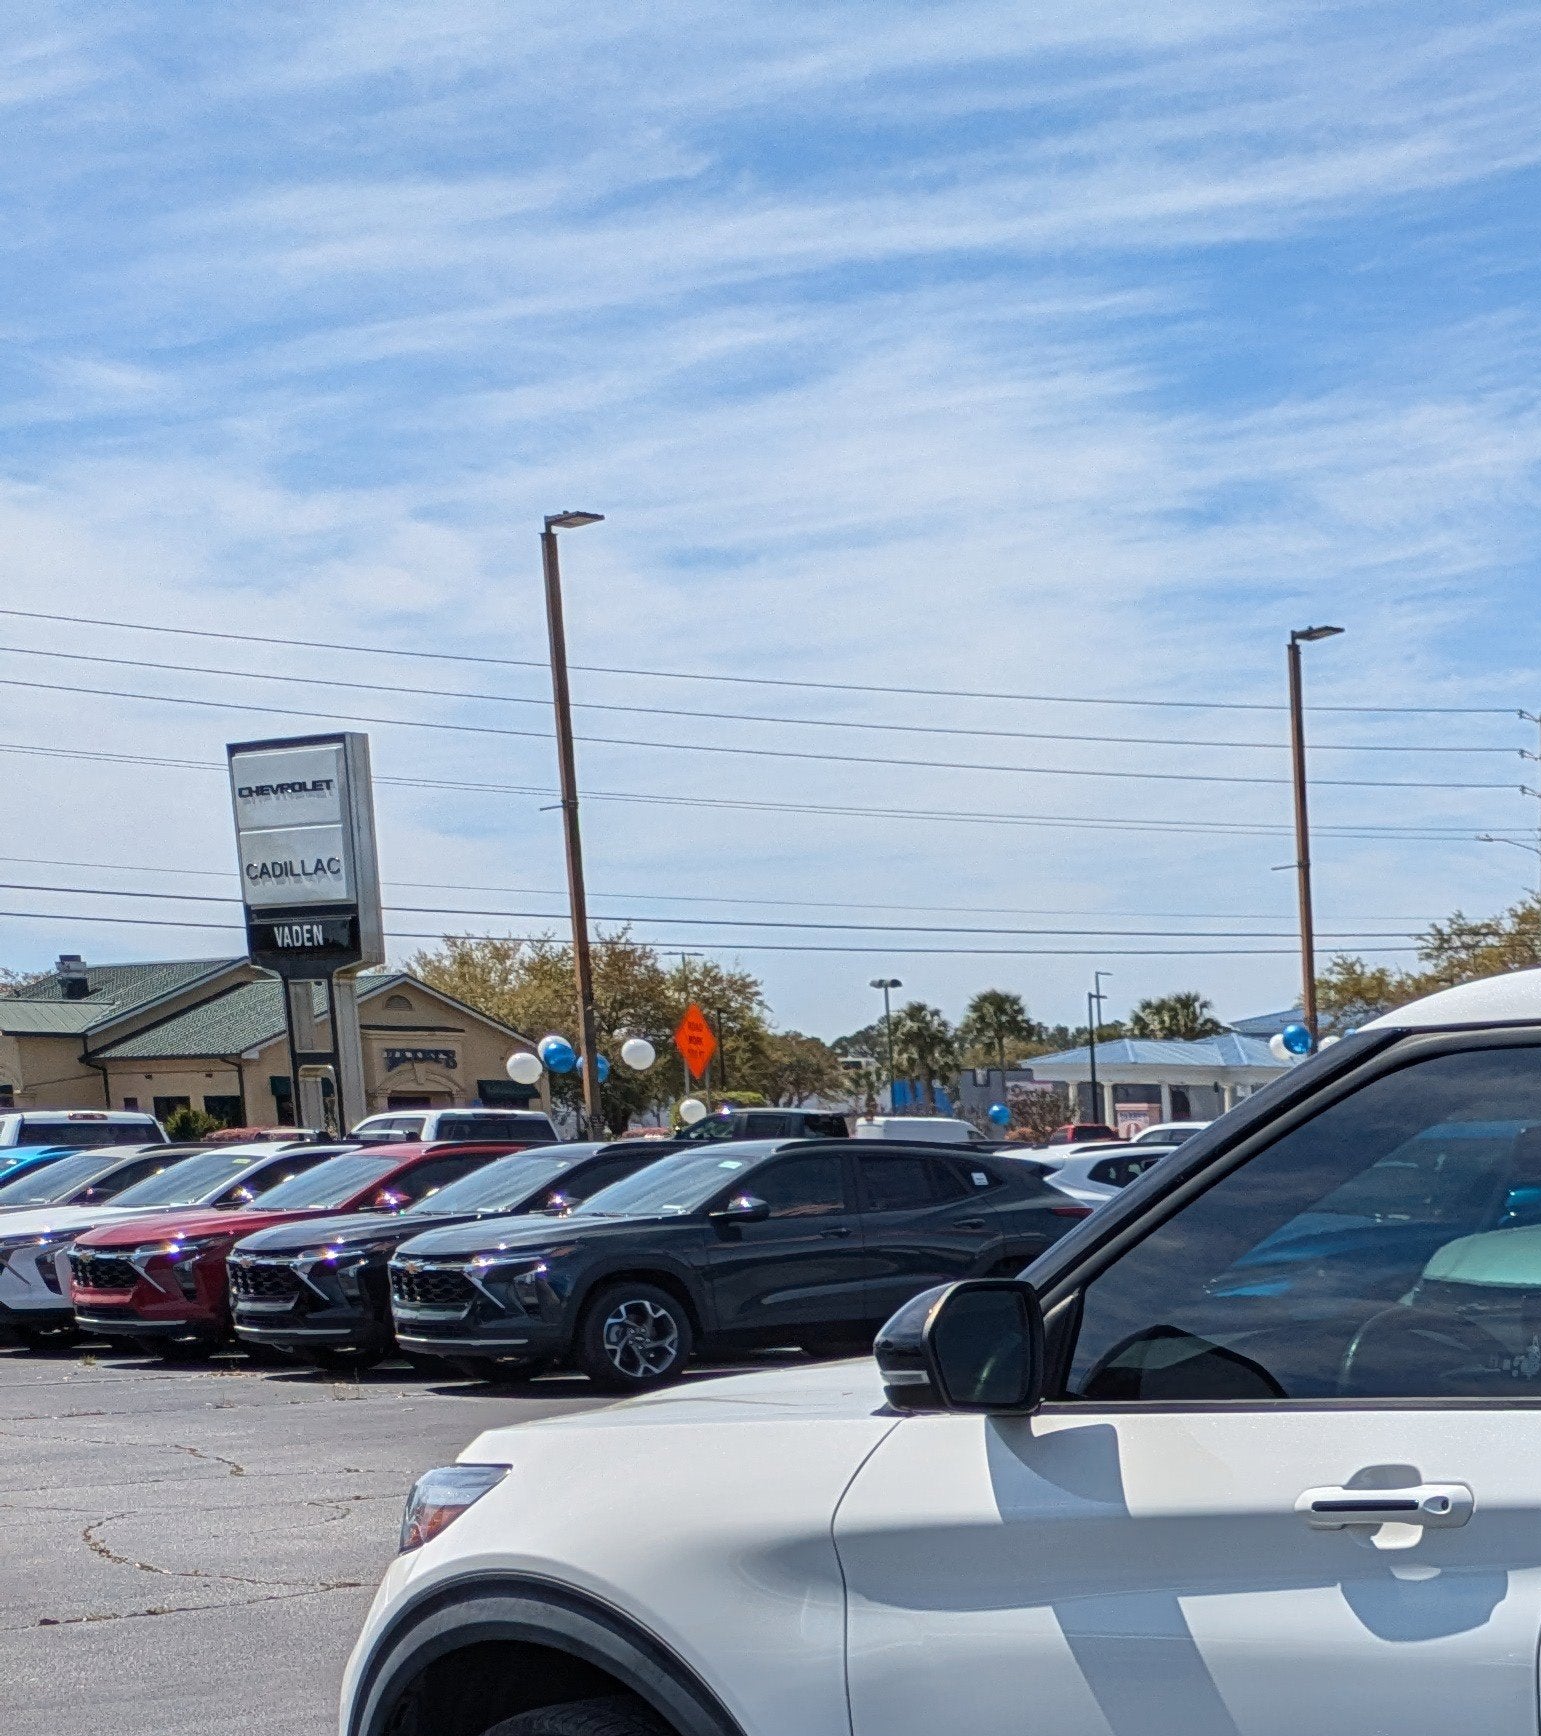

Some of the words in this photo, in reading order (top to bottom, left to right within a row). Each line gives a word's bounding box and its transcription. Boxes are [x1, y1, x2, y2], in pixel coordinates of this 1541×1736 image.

[238, 779, 334, 799] CHEVROLET
[246, 857, 341, 880] CADILLAC
[273, 924, 325, 948] VADEN
